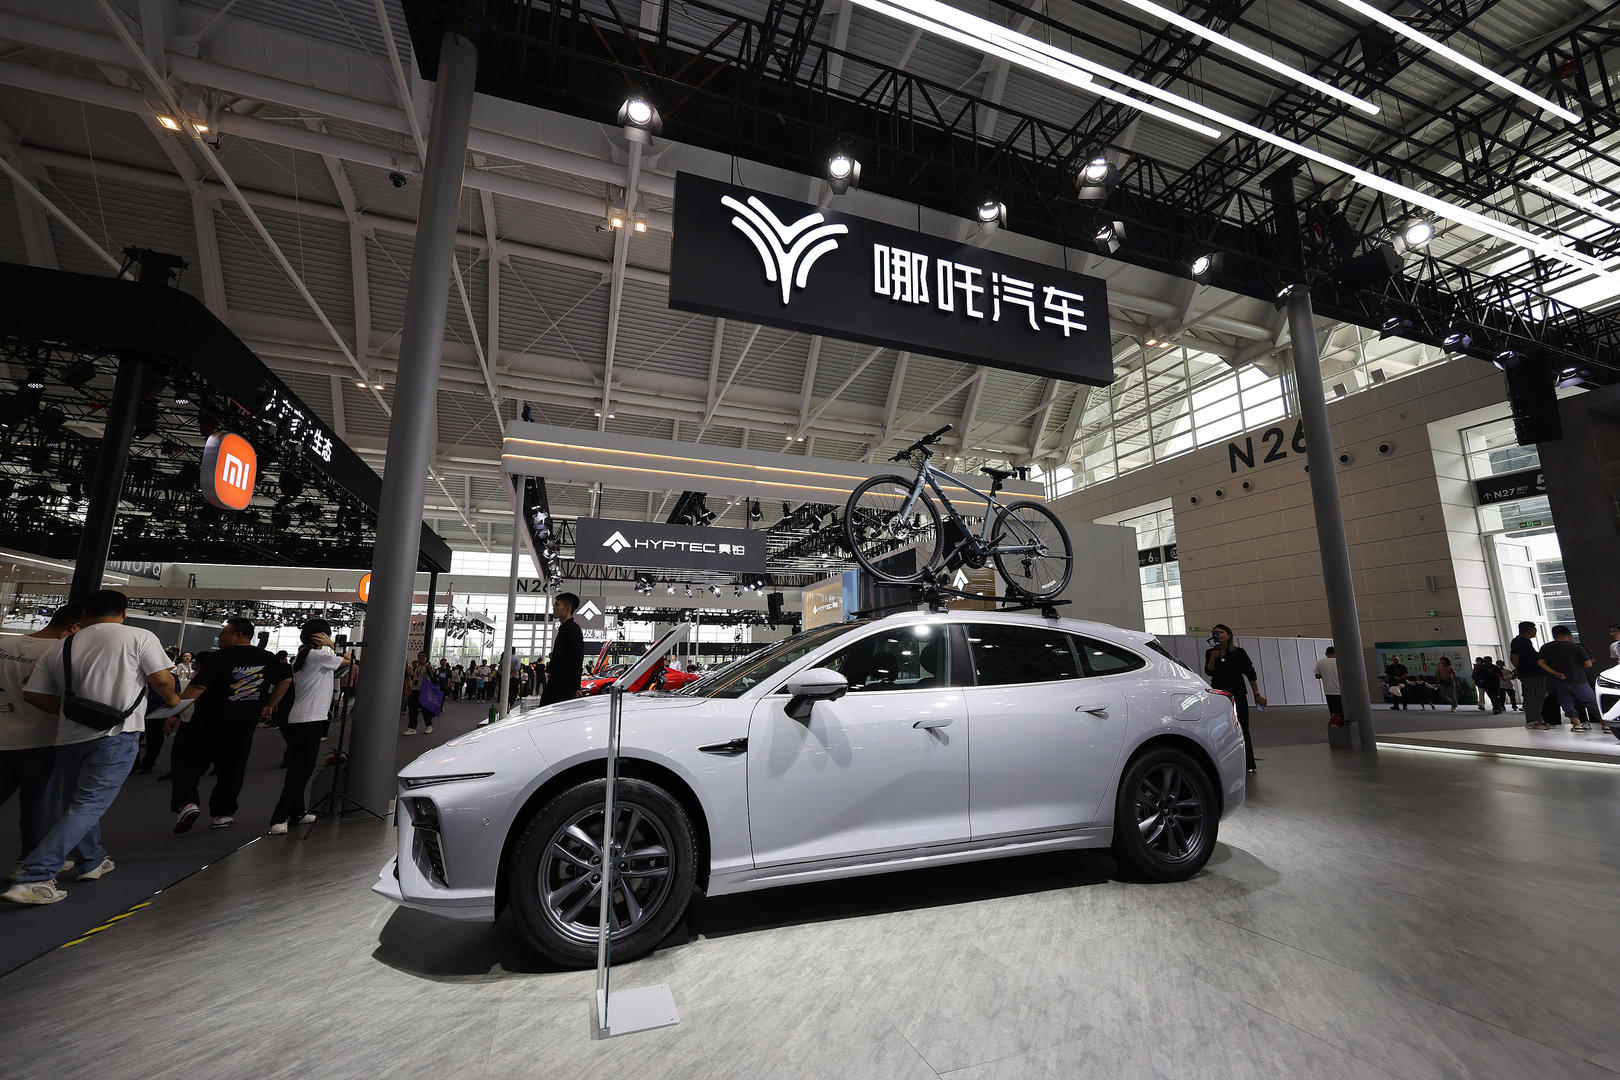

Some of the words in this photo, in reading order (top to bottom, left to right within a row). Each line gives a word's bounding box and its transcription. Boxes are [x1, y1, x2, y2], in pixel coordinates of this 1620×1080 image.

[873, 243, 1088, 338] 哪吒汽车
[1493, 487, 1515, 499] N27
[634, 538, 716, 553] HYPTEC
